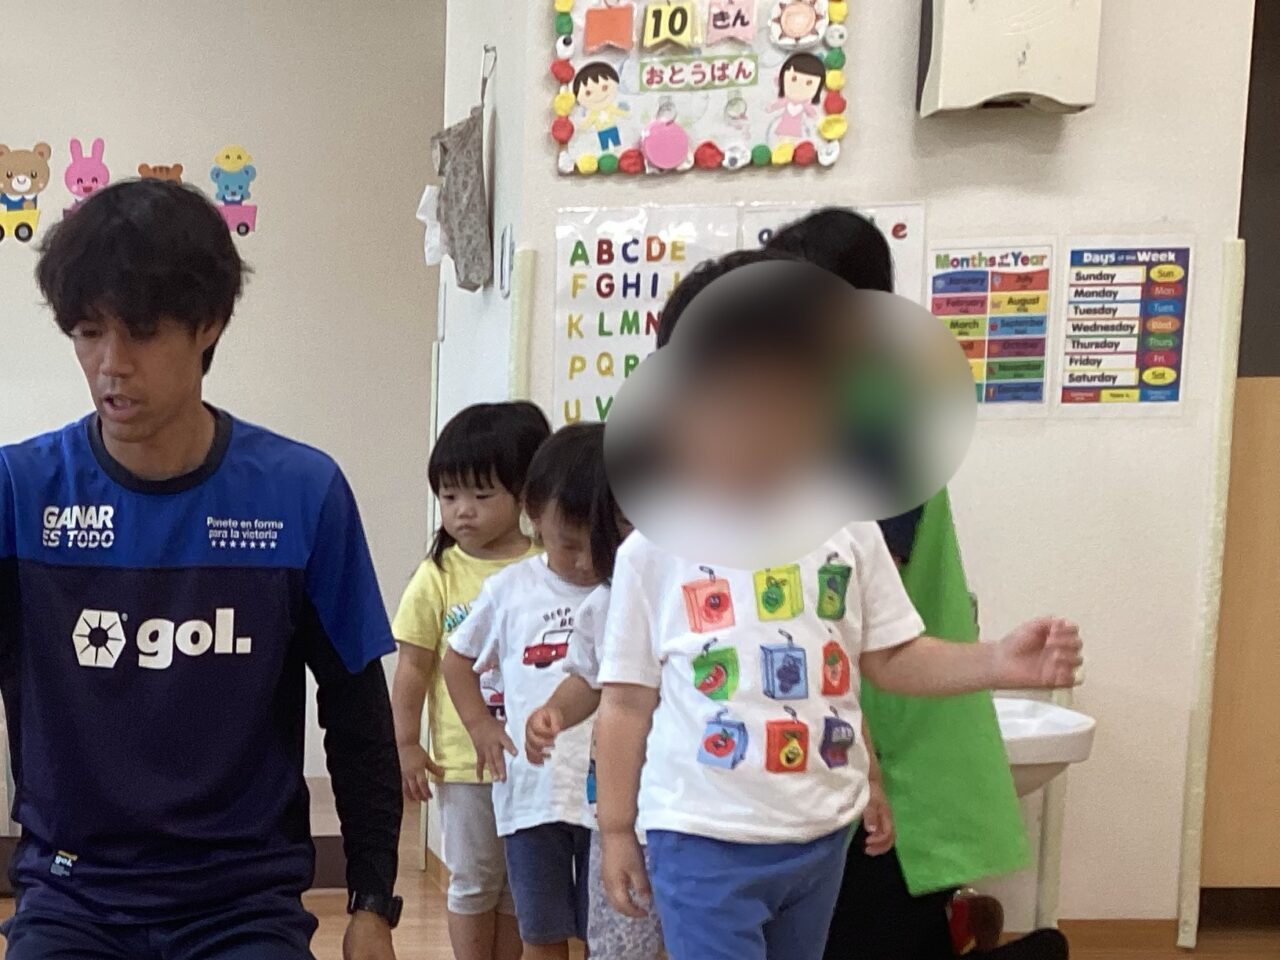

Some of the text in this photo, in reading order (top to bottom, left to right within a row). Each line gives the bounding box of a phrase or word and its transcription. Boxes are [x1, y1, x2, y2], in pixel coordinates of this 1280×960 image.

[652, 7, 688, 38] 10
[645, 61, 753, 86] おとうばん
[935, 251, 997, 269] Months
[1011, 251, 1048, 267] Year
[1083, 252, 1116, 265] Days
[1137, 250, 1176, 262] Week
[1075, 271, 1116, 283] Sunday
[1157, 269, 1175, 278] Sun
[1073, 288, 1119, 300] Monday
[1154, 286, 1175, 295] Mon
[1073, 305, 1118, 317] Tuesday
[949, 319, 979, 329] March
[1072, 322, 1136, 333] Wednesday
[1071, 339, 1120, 351] Thursday
[1069, 355, 1103, 368] Friday
[1068, 372, 1118, 384] Saturday
[43, 504, 115, 529] GANAR
[240, 520, 252, 529] en
[254, 518, 284, 530] forma
[43, 529, 115, 548] ES TODO
[230, 528, 240, 539] la
[242, 529, 278, 540] victoria
